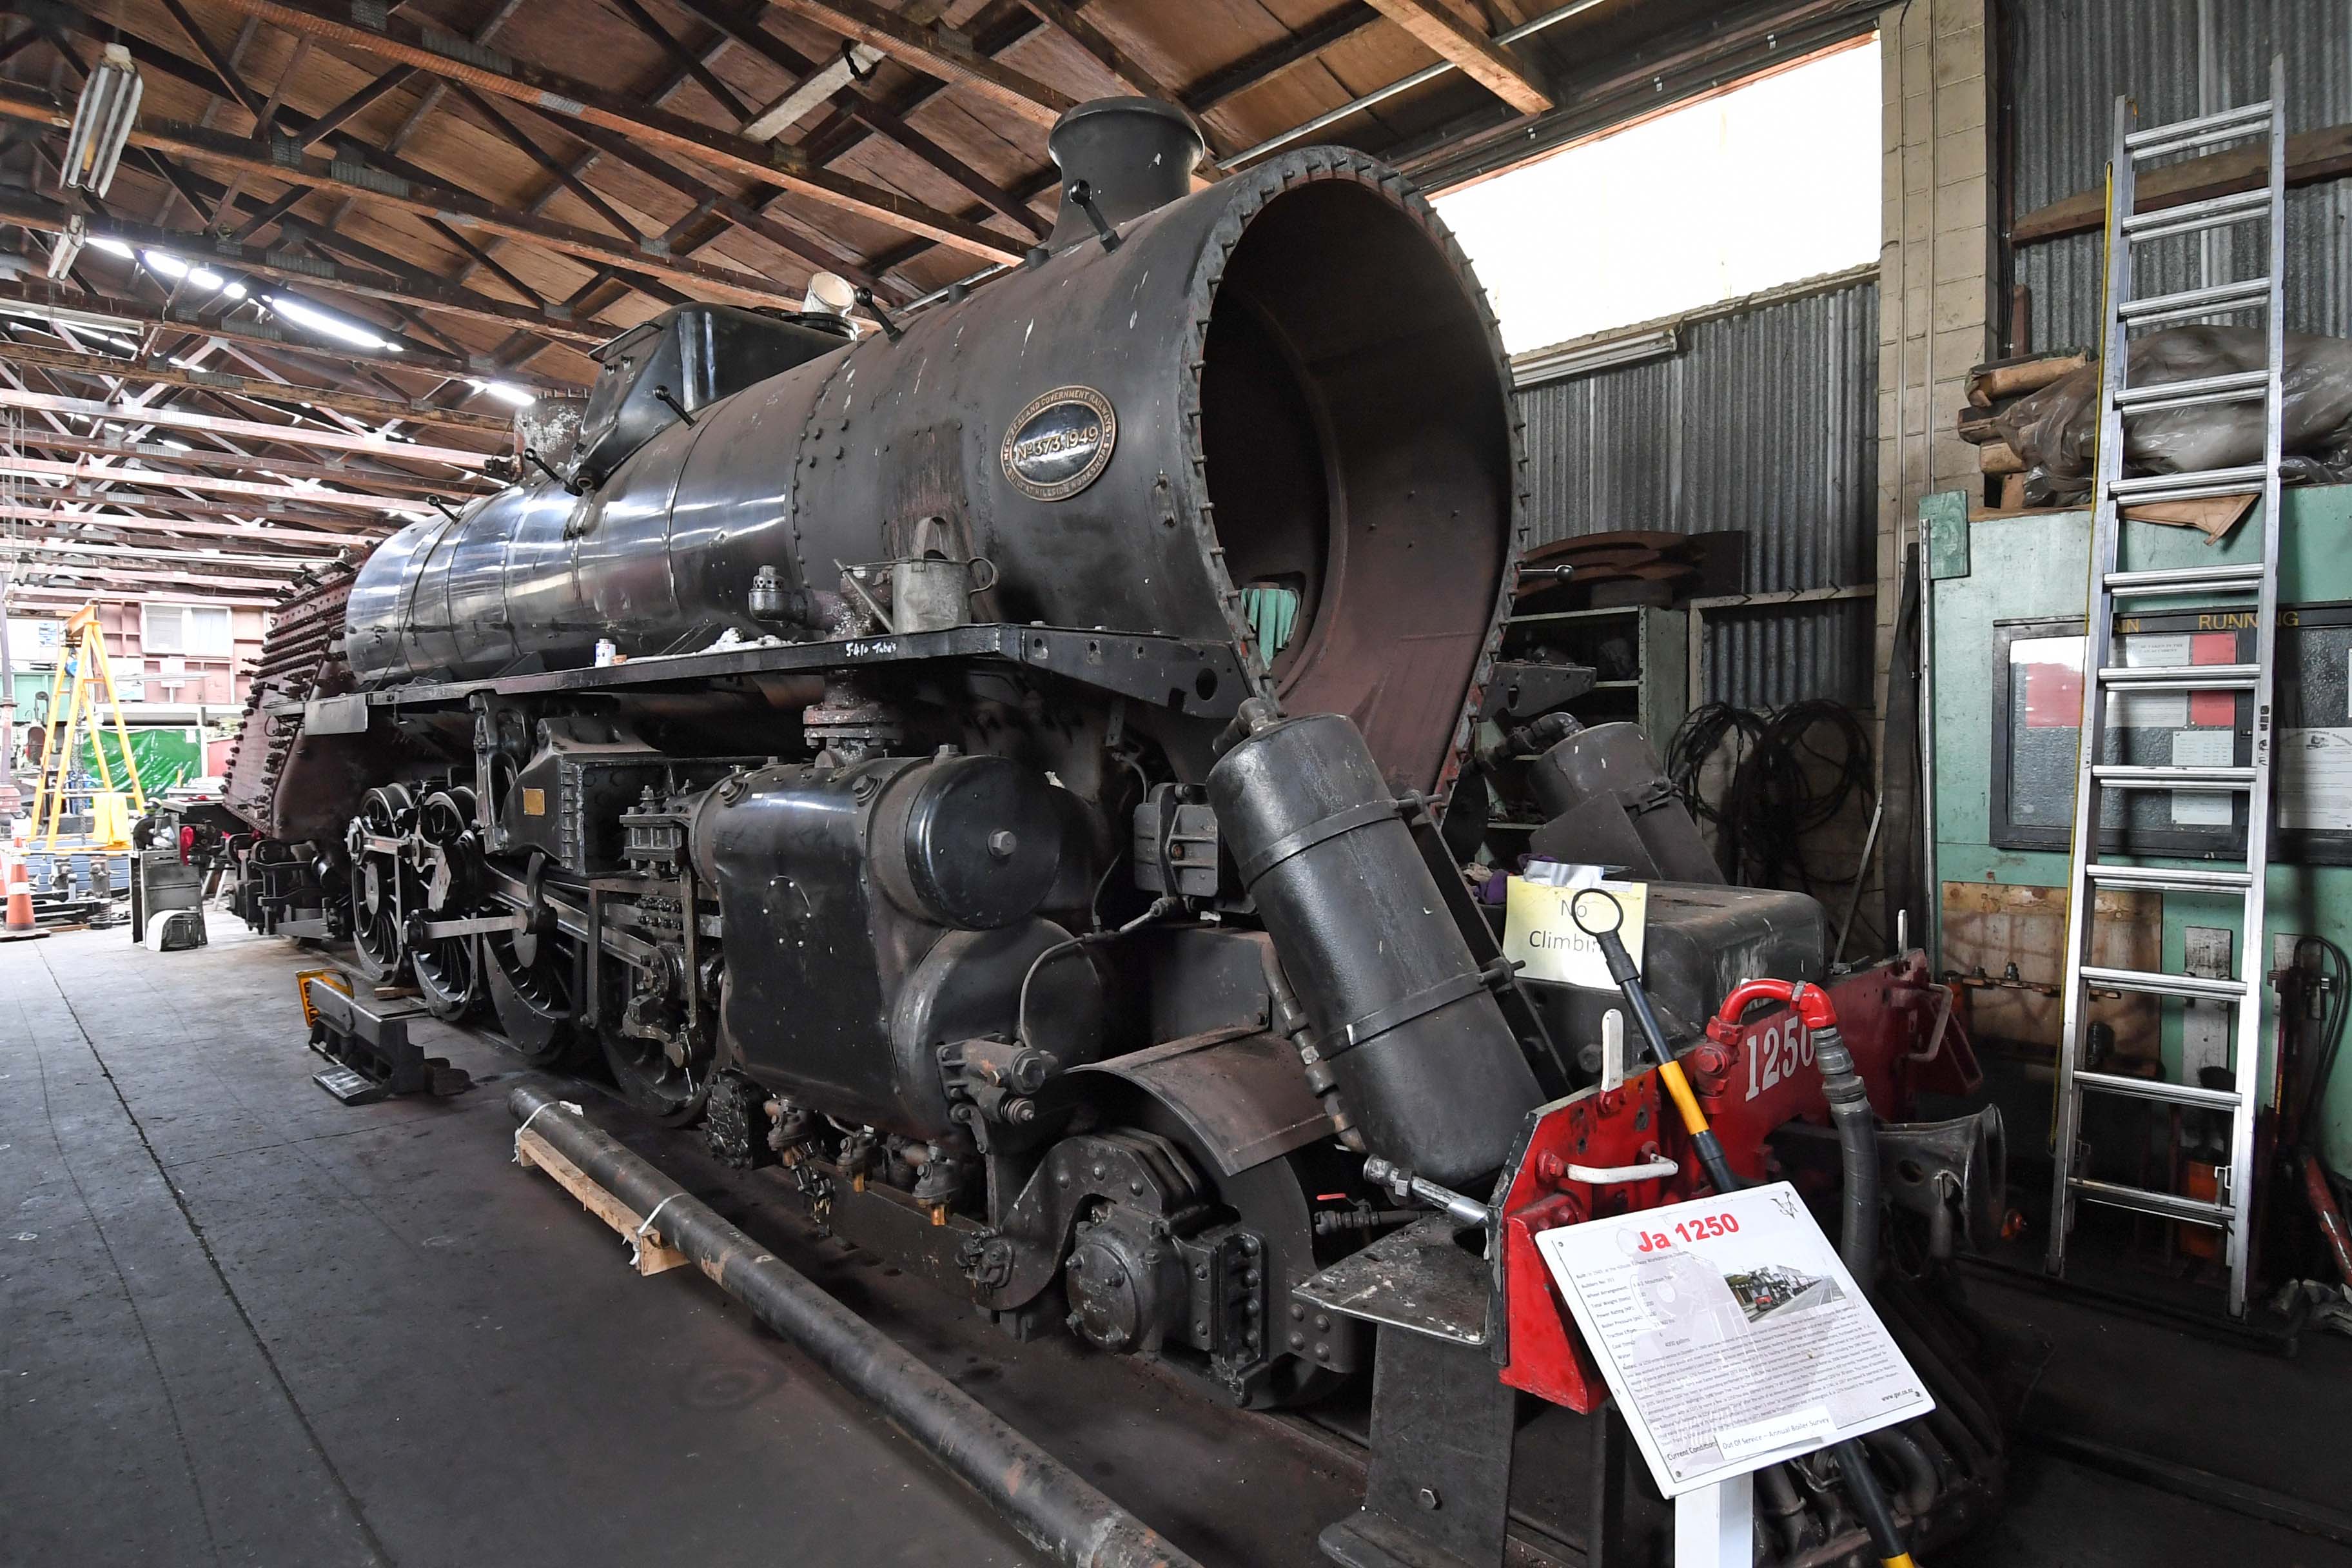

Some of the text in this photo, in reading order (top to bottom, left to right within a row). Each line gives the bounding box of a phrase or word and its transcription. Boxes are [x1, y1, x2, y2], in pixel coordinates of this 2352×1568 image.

[1010, 401, 1040, 435] ZEALAND
[1041, 389, 1090, 405] GOVERNMENT
[1089, 394, 1112, 432] RAILWAYS
[1066, 426, 1099, 448] 1949
[1007, 468, 1026, 489] BUILT
[1035, 482, 1070, 496] HILLSIDE
[1071, 443, 1110, 491] WORKSHOPS
[2199, 611, 2299, 630] RUNNG
[1561, 899, 1587, 917] No
[1529, 930, 1603, 953] Climbin
[1745, 1015, 1816, 1102] 1250
[1638, 1213, 1740, 1253] Ja 1250
[1742, 1435, 1763, 1445] Service
[1769, 1426, 1790, 1438] Annual
[1791, 1422, 1808, 1432] Boiler
[1809, 1417, 1830, 1427] Survey
[1667, 1448, 1689, 1461] Current
